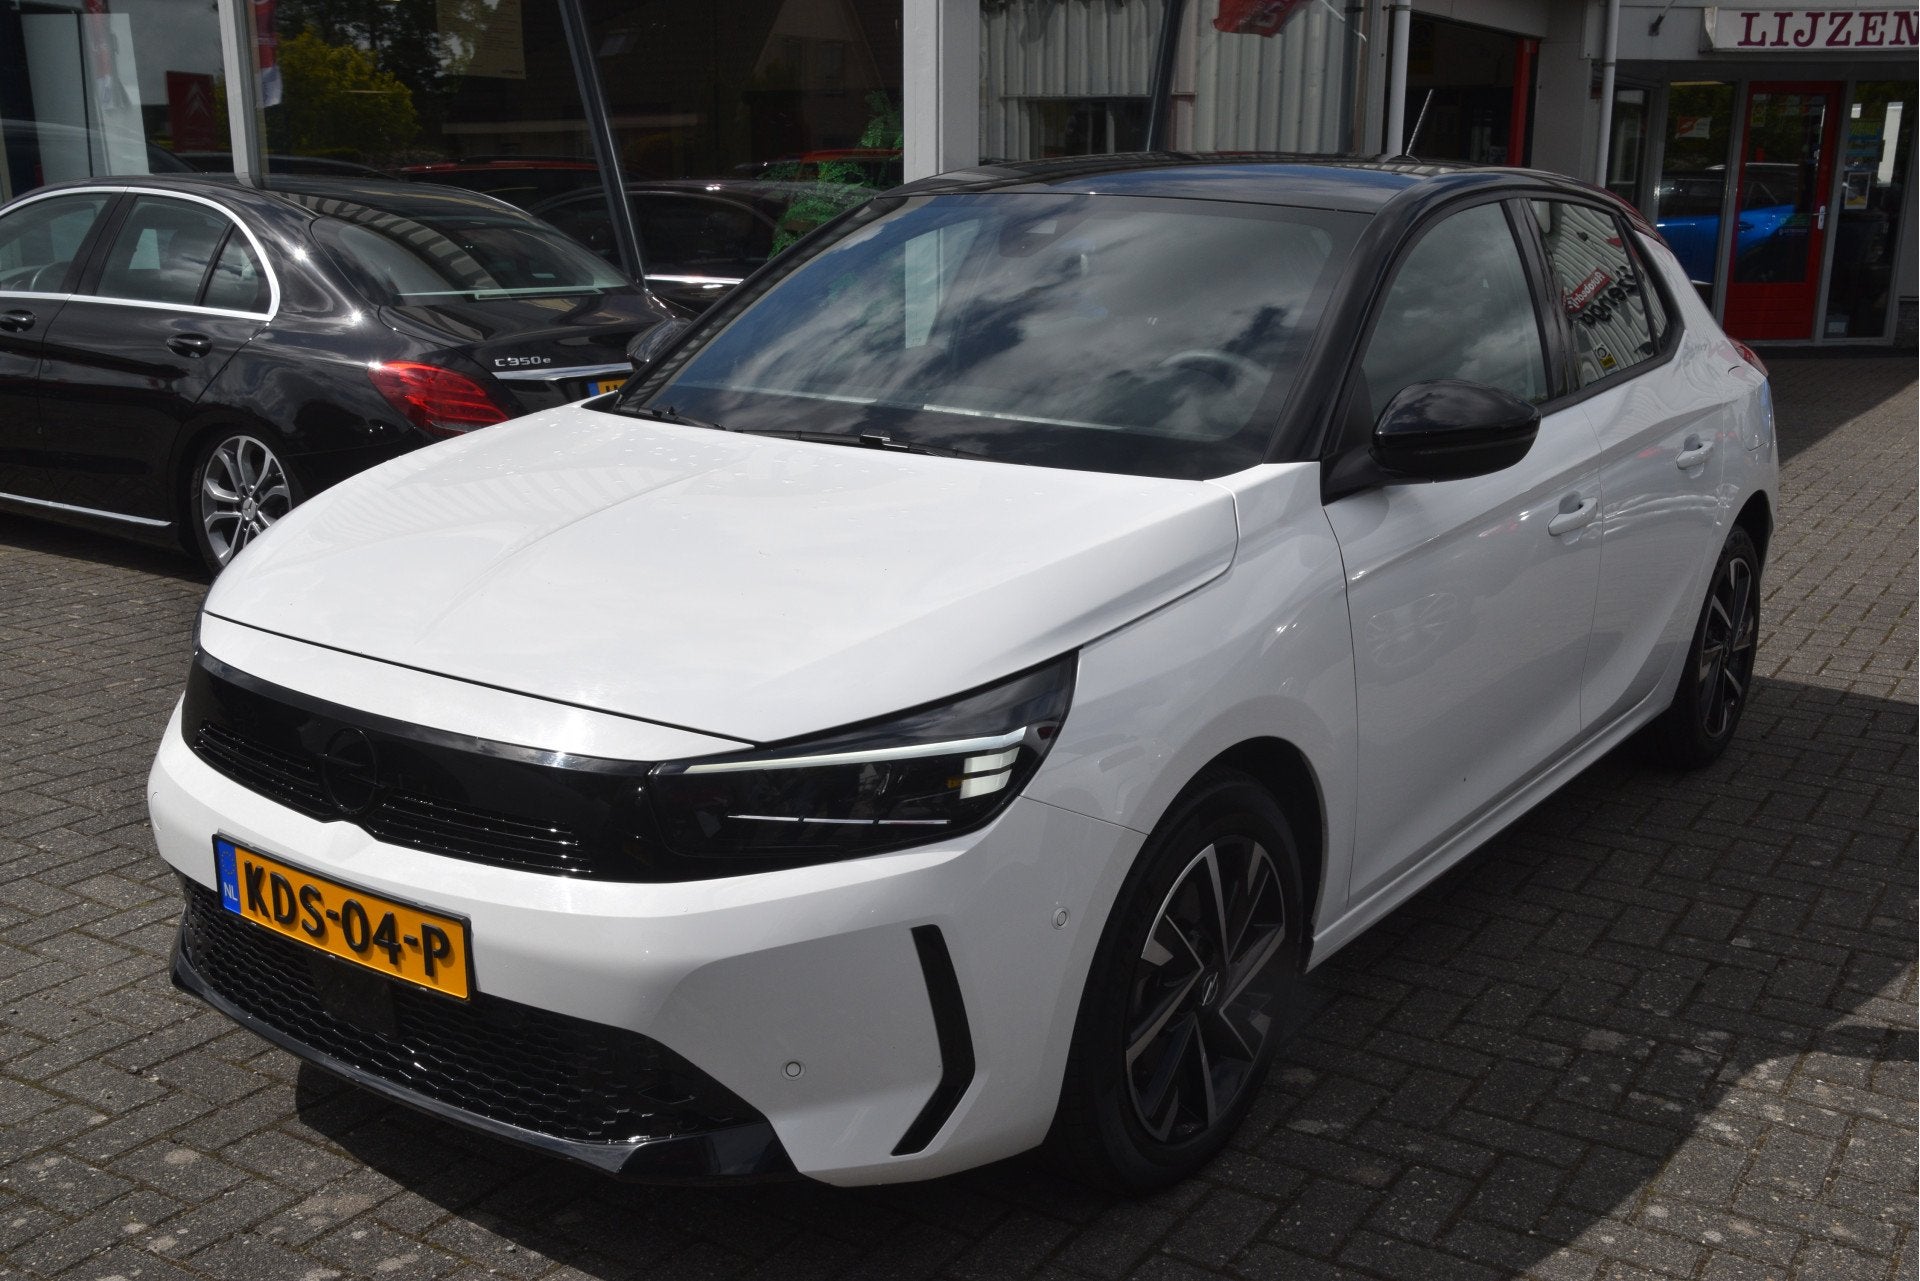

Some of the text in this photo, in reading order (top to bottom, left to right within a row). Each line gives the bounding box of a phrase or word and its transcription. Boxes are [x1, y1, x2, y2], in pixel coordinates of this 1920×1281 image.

[1737, 11, 1920, 47] LIJZEN
[223, 881, 238, 902] NL
[243, 860, 451, 977] KDS-04-P
